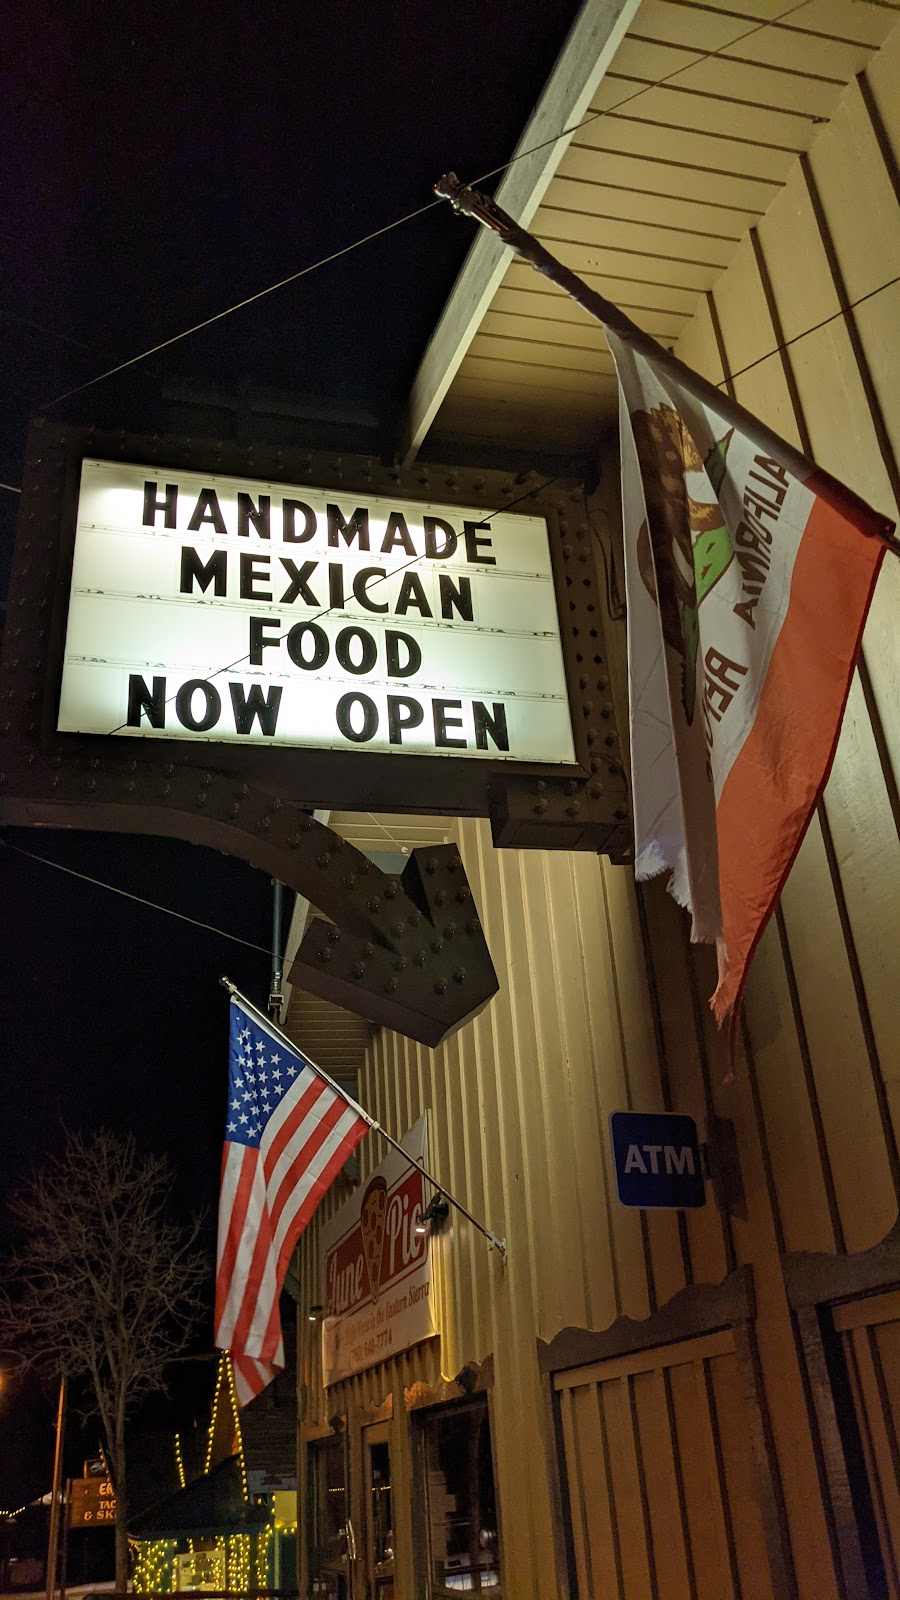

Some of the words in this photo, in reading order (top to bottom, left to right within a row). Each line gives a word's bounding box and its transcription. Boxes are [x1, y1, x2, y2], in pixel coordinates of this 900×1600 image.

[142, 481, 496, 565] HANDMADE
[180, 546, 474, 621] MEXICAN
[249, 616, 422, 678] FOOD
[126, 674, 283, 737] NOW
[336, 691, 510, 752] OPEN
[624, 1144, 695, 1175] ATM
[327, 1251, 364, 1315] June
[386, 1193, 422, 1276] Pie
[408, 1281, 430, 1307] Sierra
[98, 1500, 117, 1510] TAC
